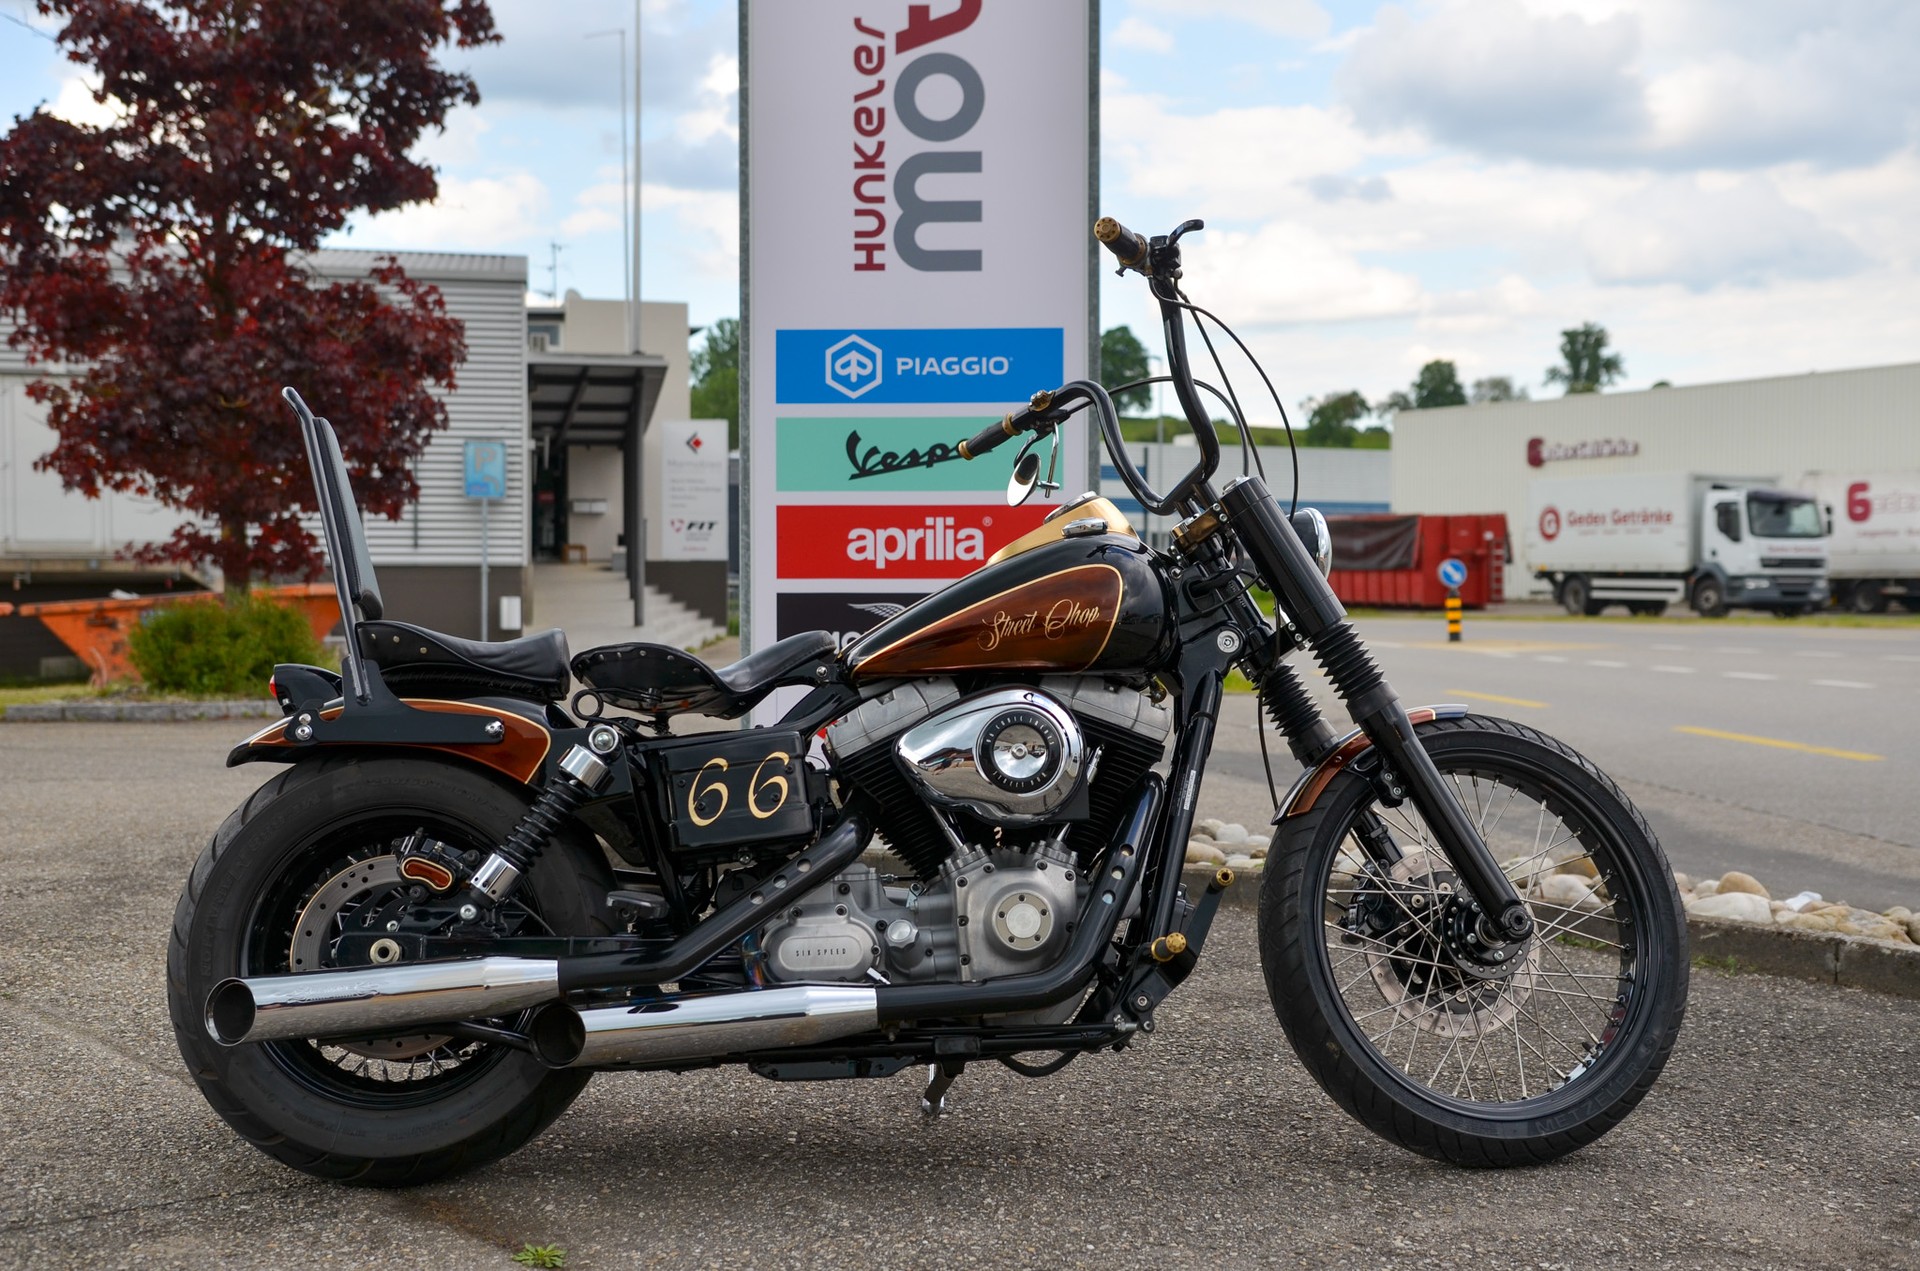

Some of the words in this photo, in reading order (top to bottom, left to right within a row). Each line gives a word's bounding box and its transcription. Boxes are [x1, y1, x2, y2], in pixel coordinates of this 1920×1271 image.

[896, 356, 1009, 376] PIAGGIO
[846, 516, 984, 569] aprilia
[977, 610, 1038, 652] Street
[817, 948, 846, 956] SPEED
